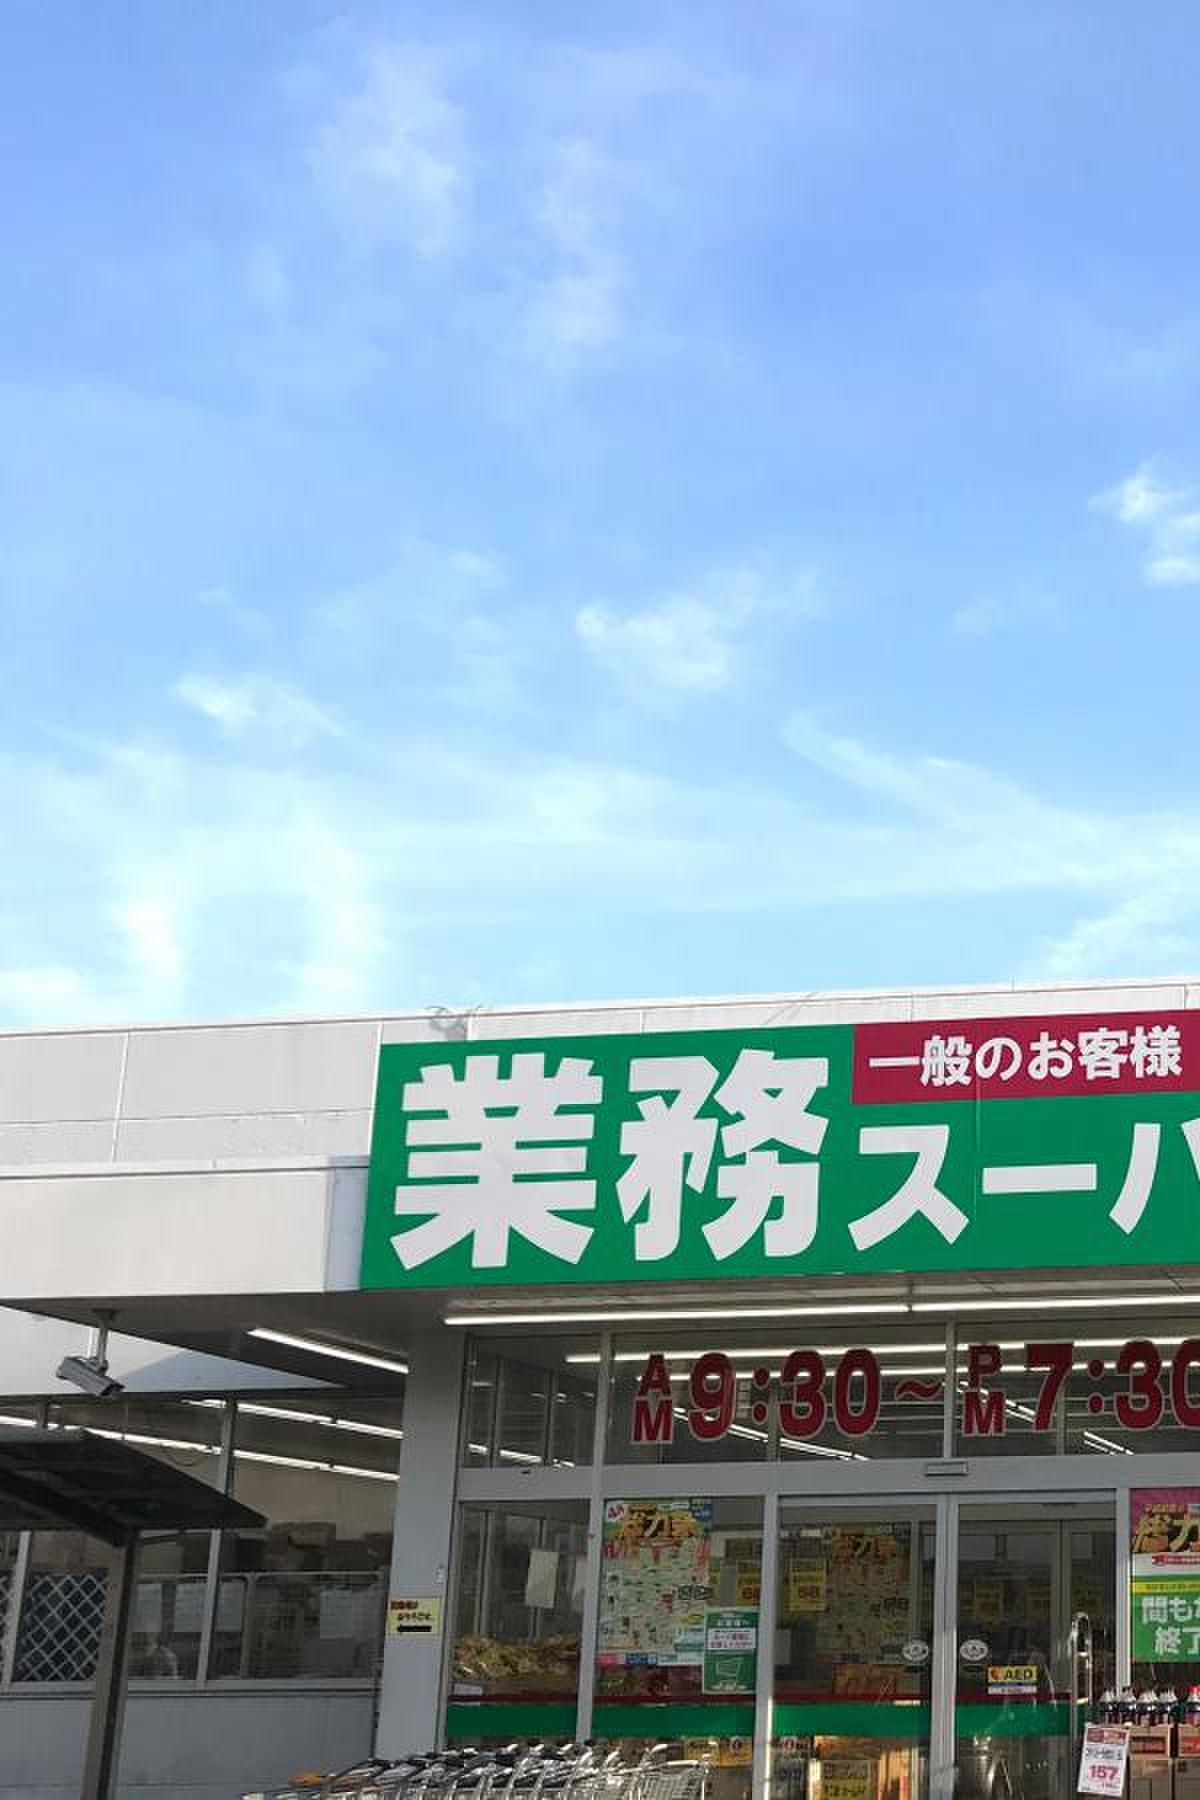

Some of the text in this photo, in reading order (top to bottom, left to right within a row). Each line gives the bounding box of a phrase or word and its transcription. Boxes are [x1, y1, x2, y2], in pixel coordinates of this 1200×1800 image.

[869, 1024, 1182, 1087] 一般のお客様
[688, 1348, 881, 1440] 9:30
